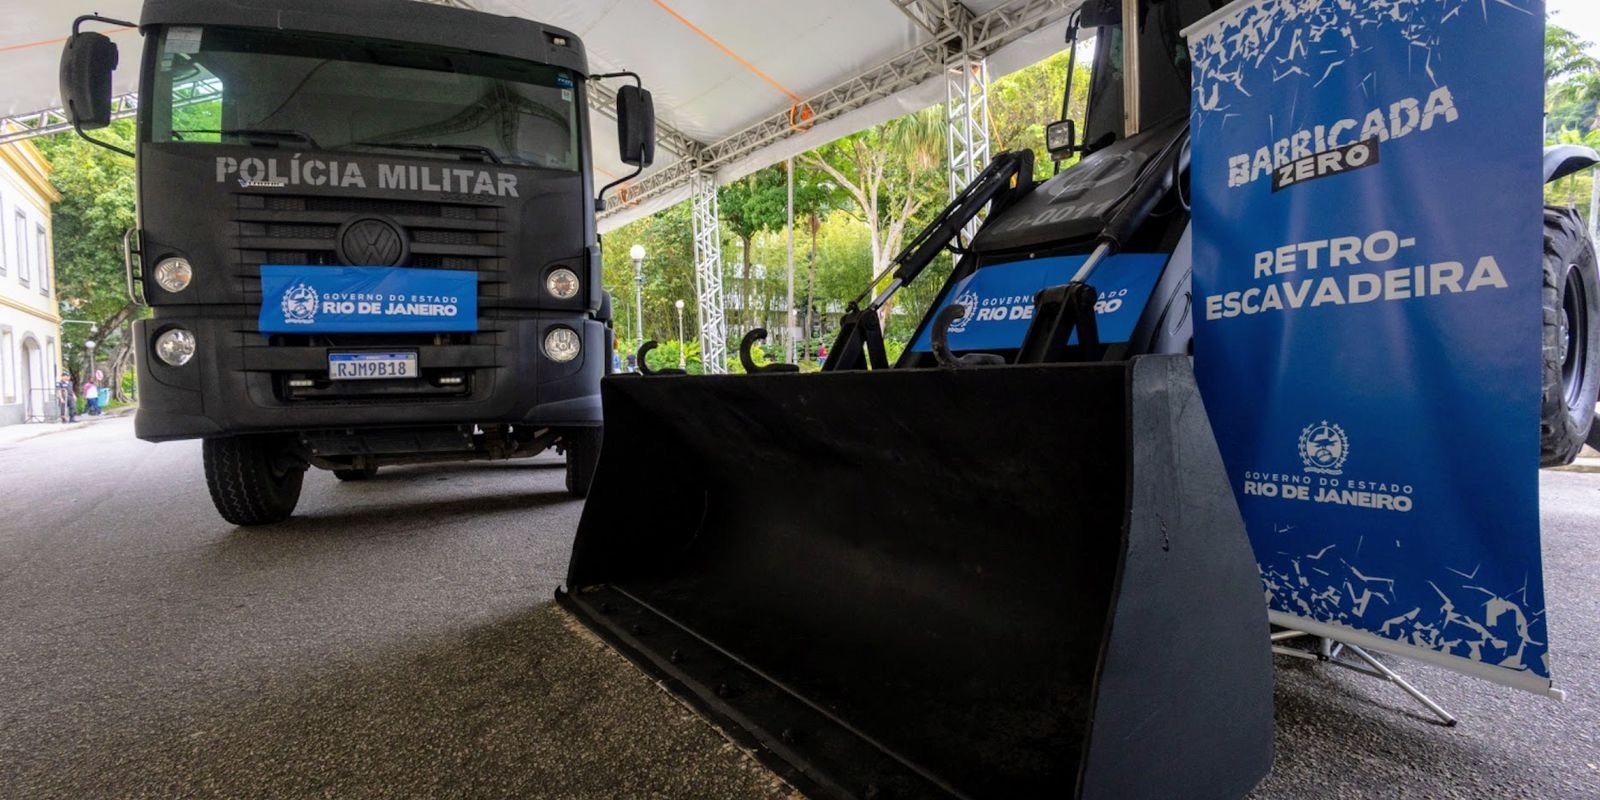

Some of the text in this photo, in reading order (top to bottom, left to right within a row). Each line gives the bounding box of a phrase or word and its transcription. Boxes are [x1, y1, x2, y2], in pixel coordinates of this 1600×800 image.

[1228, 86, 1459, 188] BARRICADA
[216, 153, 519, 197] POLÍCIA MILITAR
[1278, 144, 1370, 187] ZERO
[1254, 230, 1416, 279] RETRO-
[322, 293, 458, 304] GOVERNO DO ESTADO
[1205, 255, 1509, 321] ESCAVADEIRA
[322, 301, 458, 317] RIO DE JANEIRO
[977, 305, 1034, 321] RIO DE
[338, 361, 406, 377] RJM9B18
[1244, 471, 1413, 494] GOVERNO DO ESTADO
[1244, 480, 1413, 512] RIO DE JANEIRO
